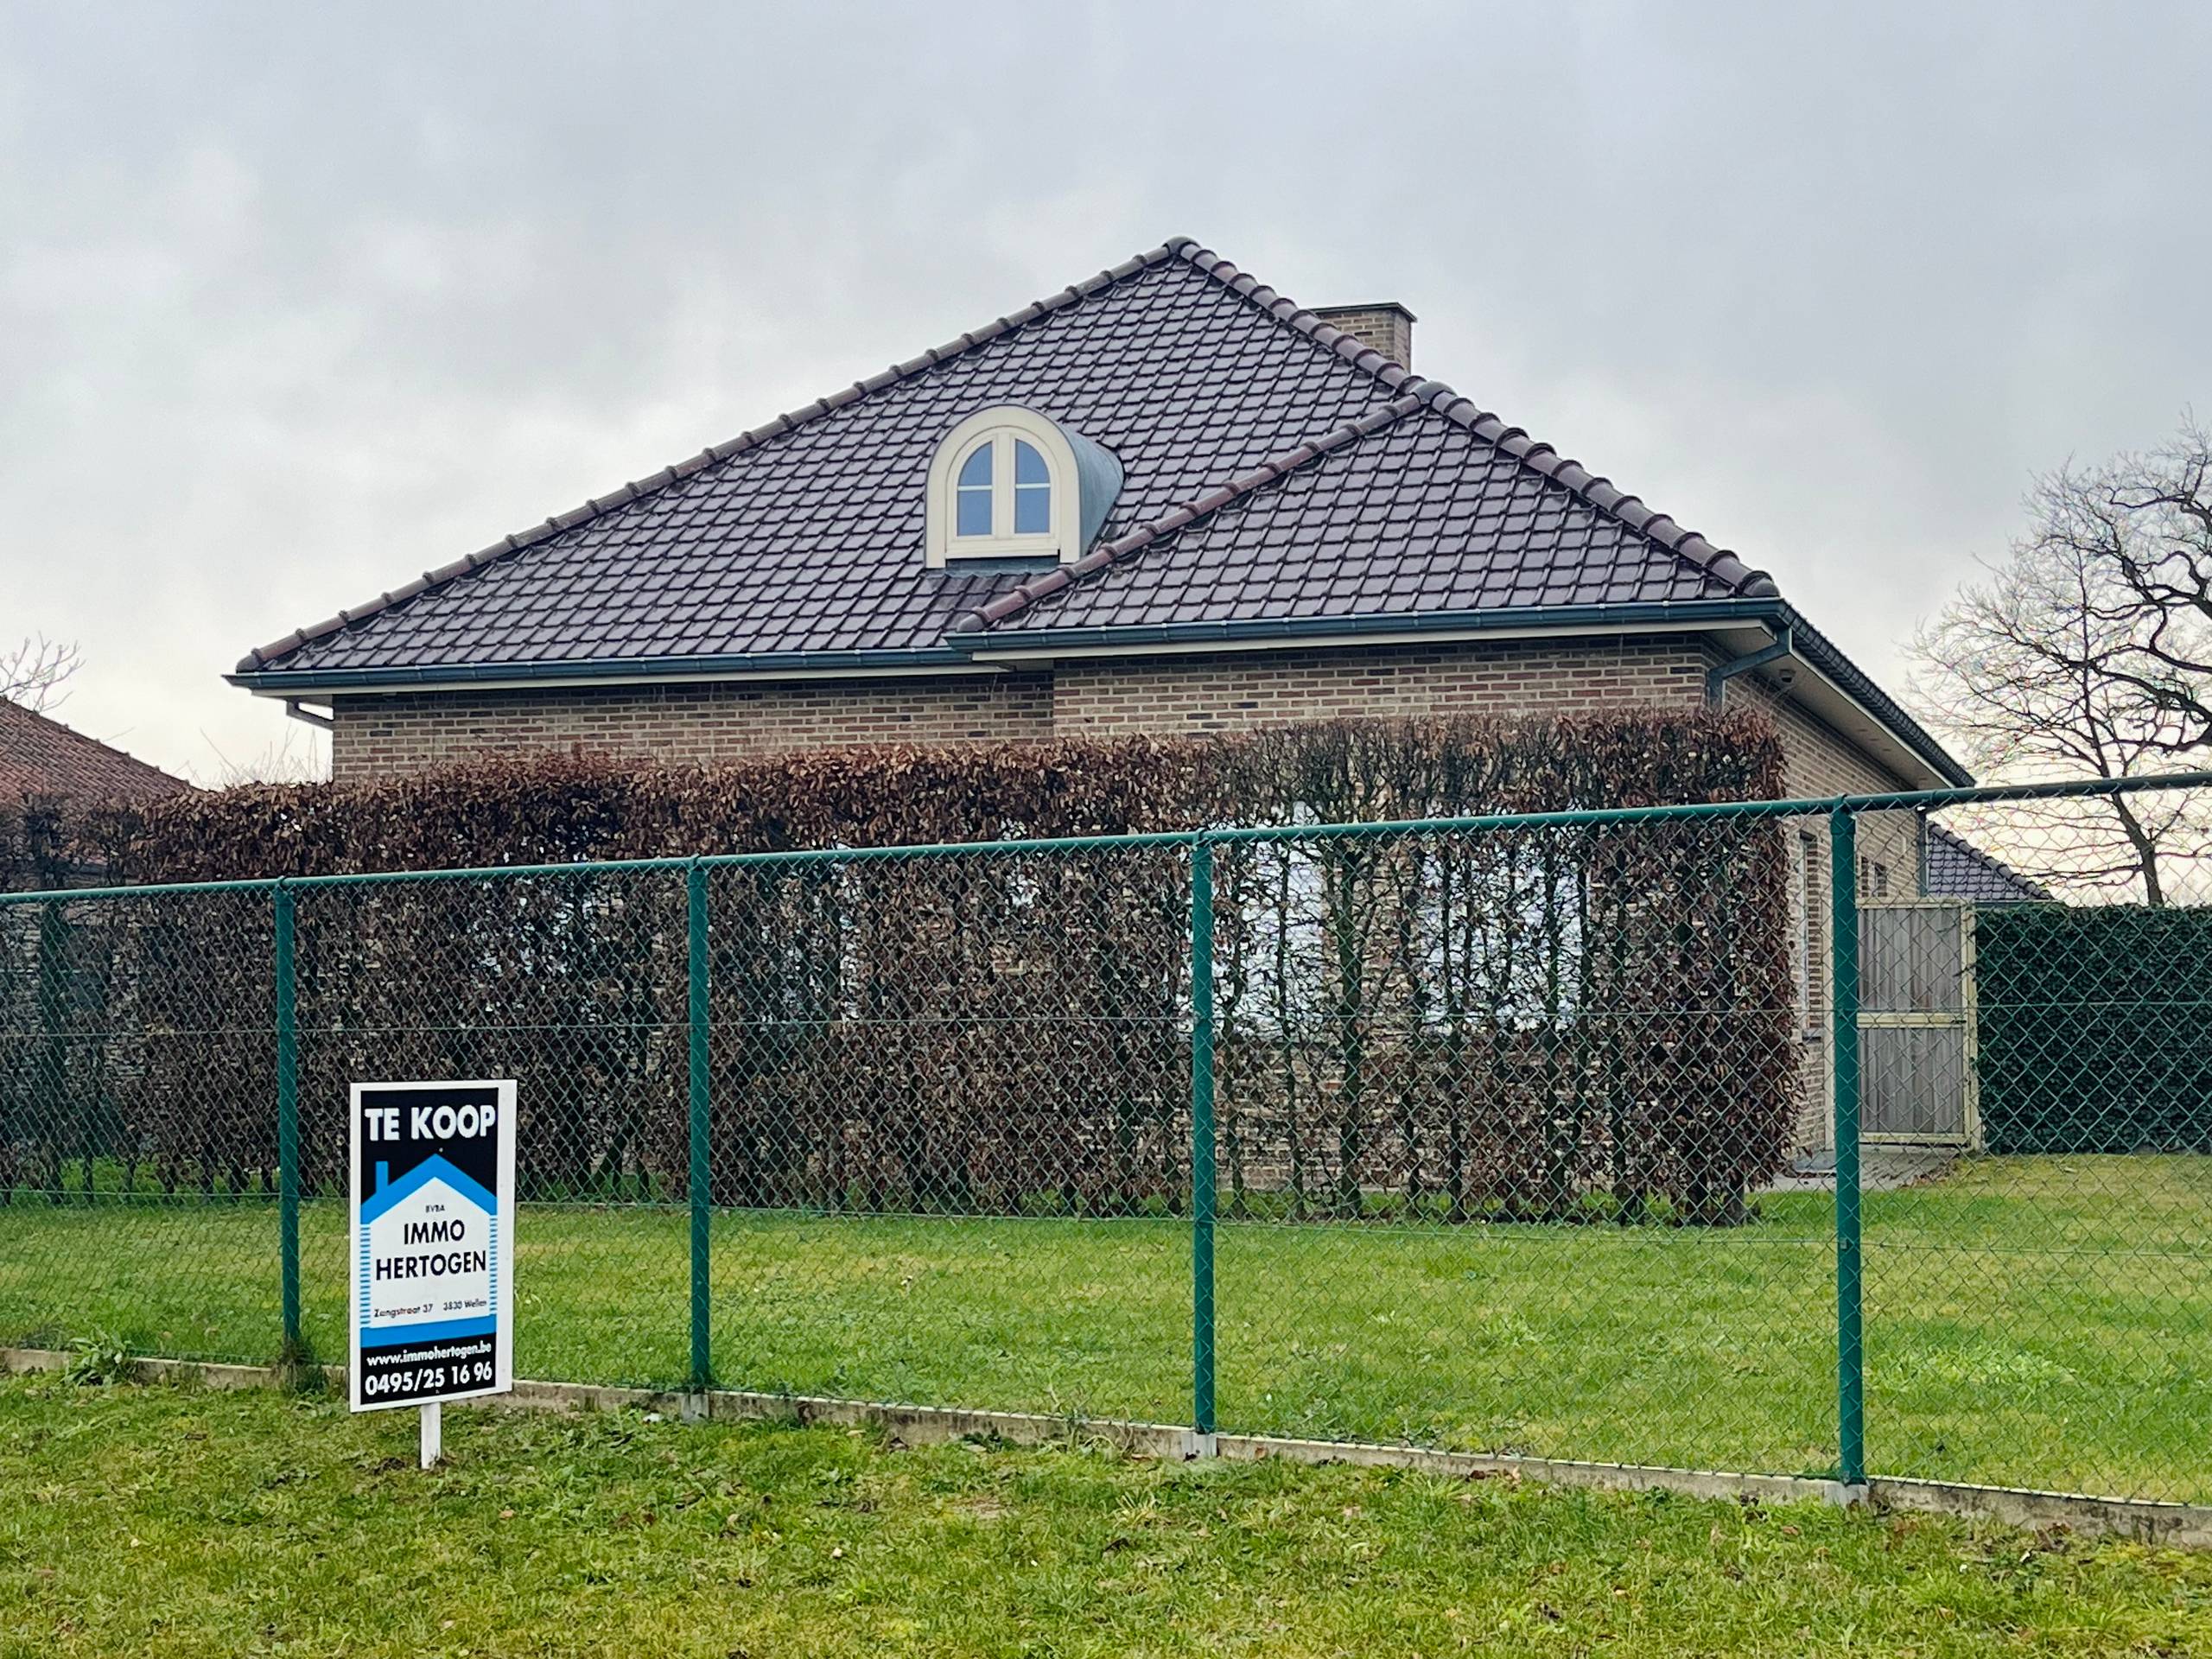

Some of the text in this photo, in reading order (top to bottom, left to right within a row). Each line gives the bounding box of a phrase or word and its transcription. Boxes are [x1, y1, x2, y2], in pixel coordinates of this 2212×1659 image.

[365, 1105, 495, 1141] TE KOOP
[404, 1219, 465, 1244] IMMO
[376, 1250, 486, 1281] HERTOGEN
[465, 1299, 486, 1308] Wellen
[366, 1340, 492, 1366] www.immohertogen.be
[365, 1361, 493, 1395] 0495/25 16 96
